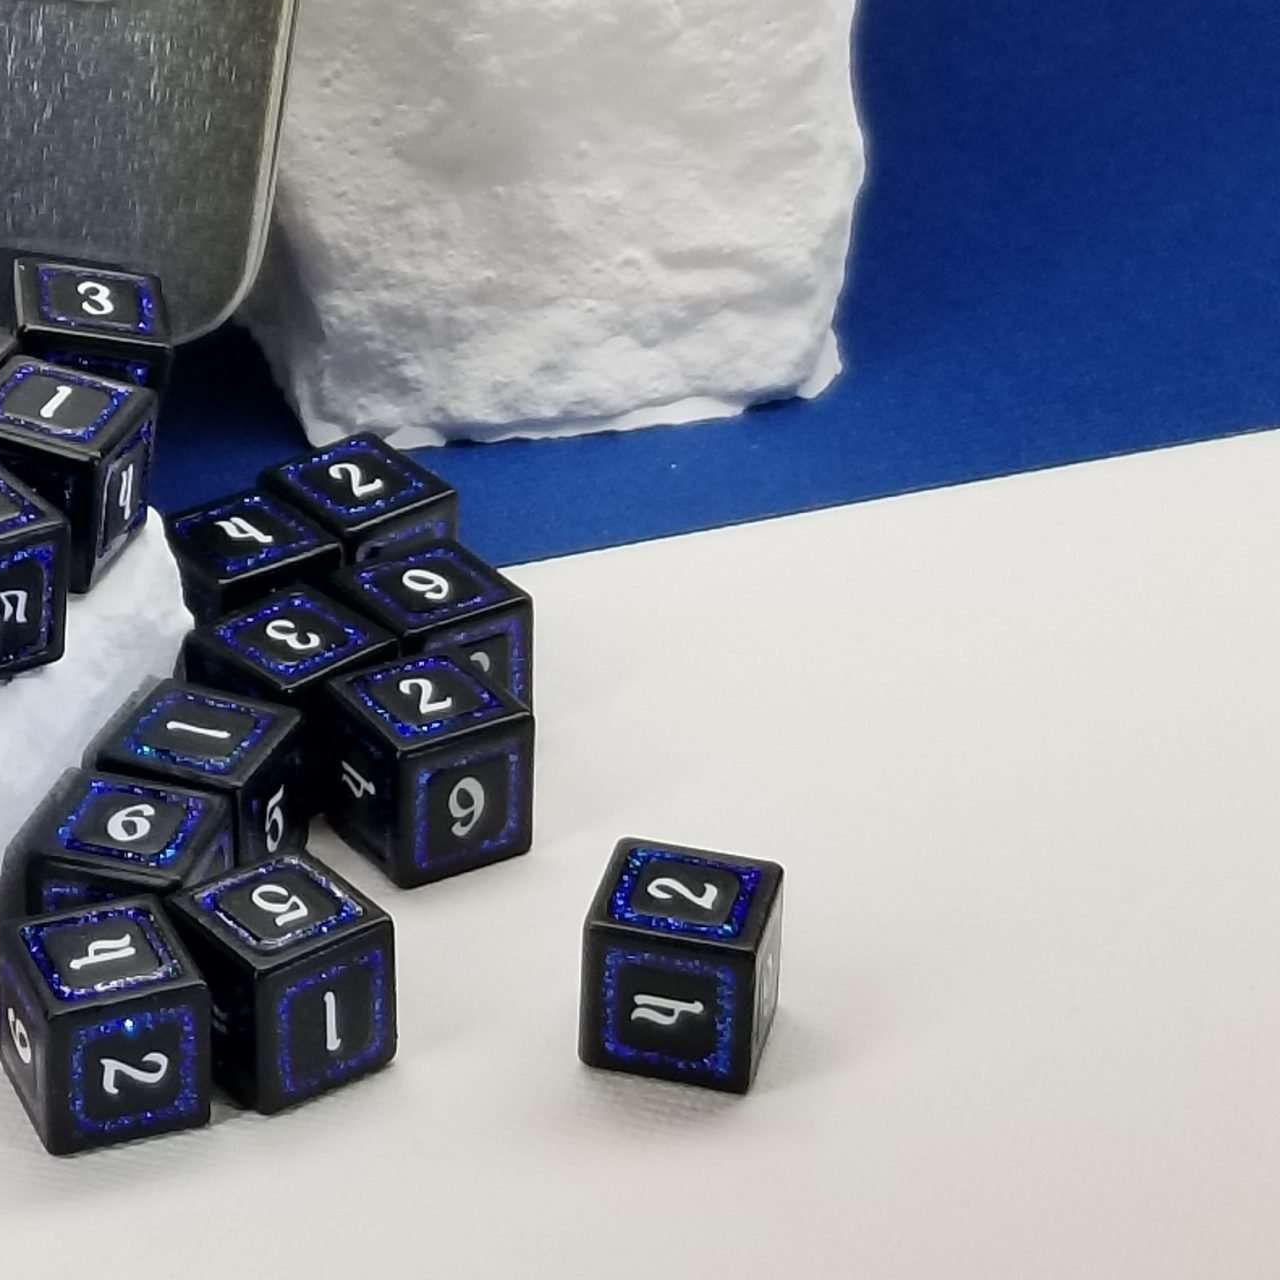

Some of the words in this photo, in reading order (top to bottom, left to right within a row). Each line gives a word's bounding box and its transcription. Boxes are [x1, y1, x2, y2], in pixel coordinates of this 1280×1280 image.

[77, 281, 114, 315] 3
[40, 385, 73, 418] 1
[328, 463, 384, 498] 2
[215, 516, 273, 544] 4
[265, 619, 321, 650] 3
[399, 678, 453, 715] 2
[166, 720, 231, 739] 1
[342, 761, 376, 798] 4
[107, 804, 155, 842] 6
[251, 884, 309, 927] 5
[647, 877, 718, 910] 2
[323, 991, 342, 1051] 1
[100, 1052, 169, 1095] 2
